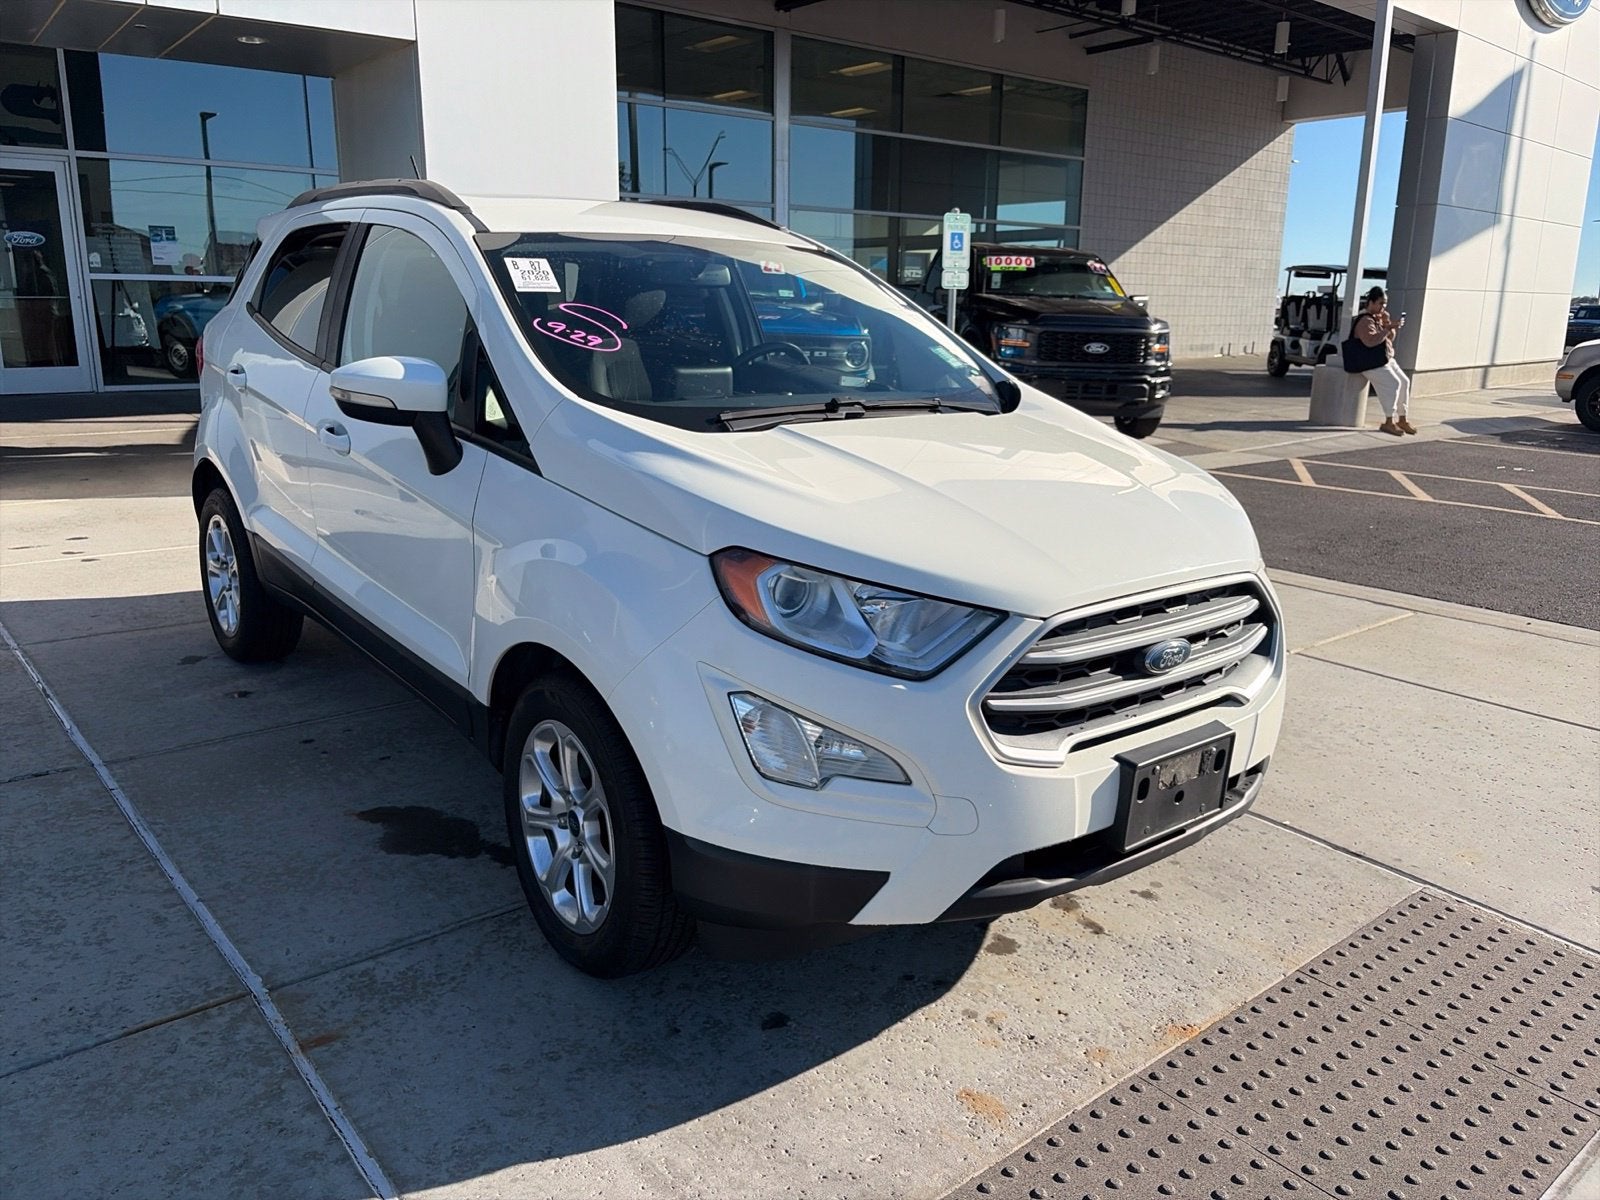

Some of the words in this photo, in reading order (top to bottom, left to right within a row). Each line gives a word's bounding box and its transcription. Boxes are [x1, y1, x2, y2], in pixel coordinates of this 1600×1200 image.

[12, 234, 37, 244] Ford
[511, 260, 519, 269] B
[529, 260, 541, 270] 87
[547, 322, 602, 346] 9-29
[1160, 647, 1185, 668] Ford
